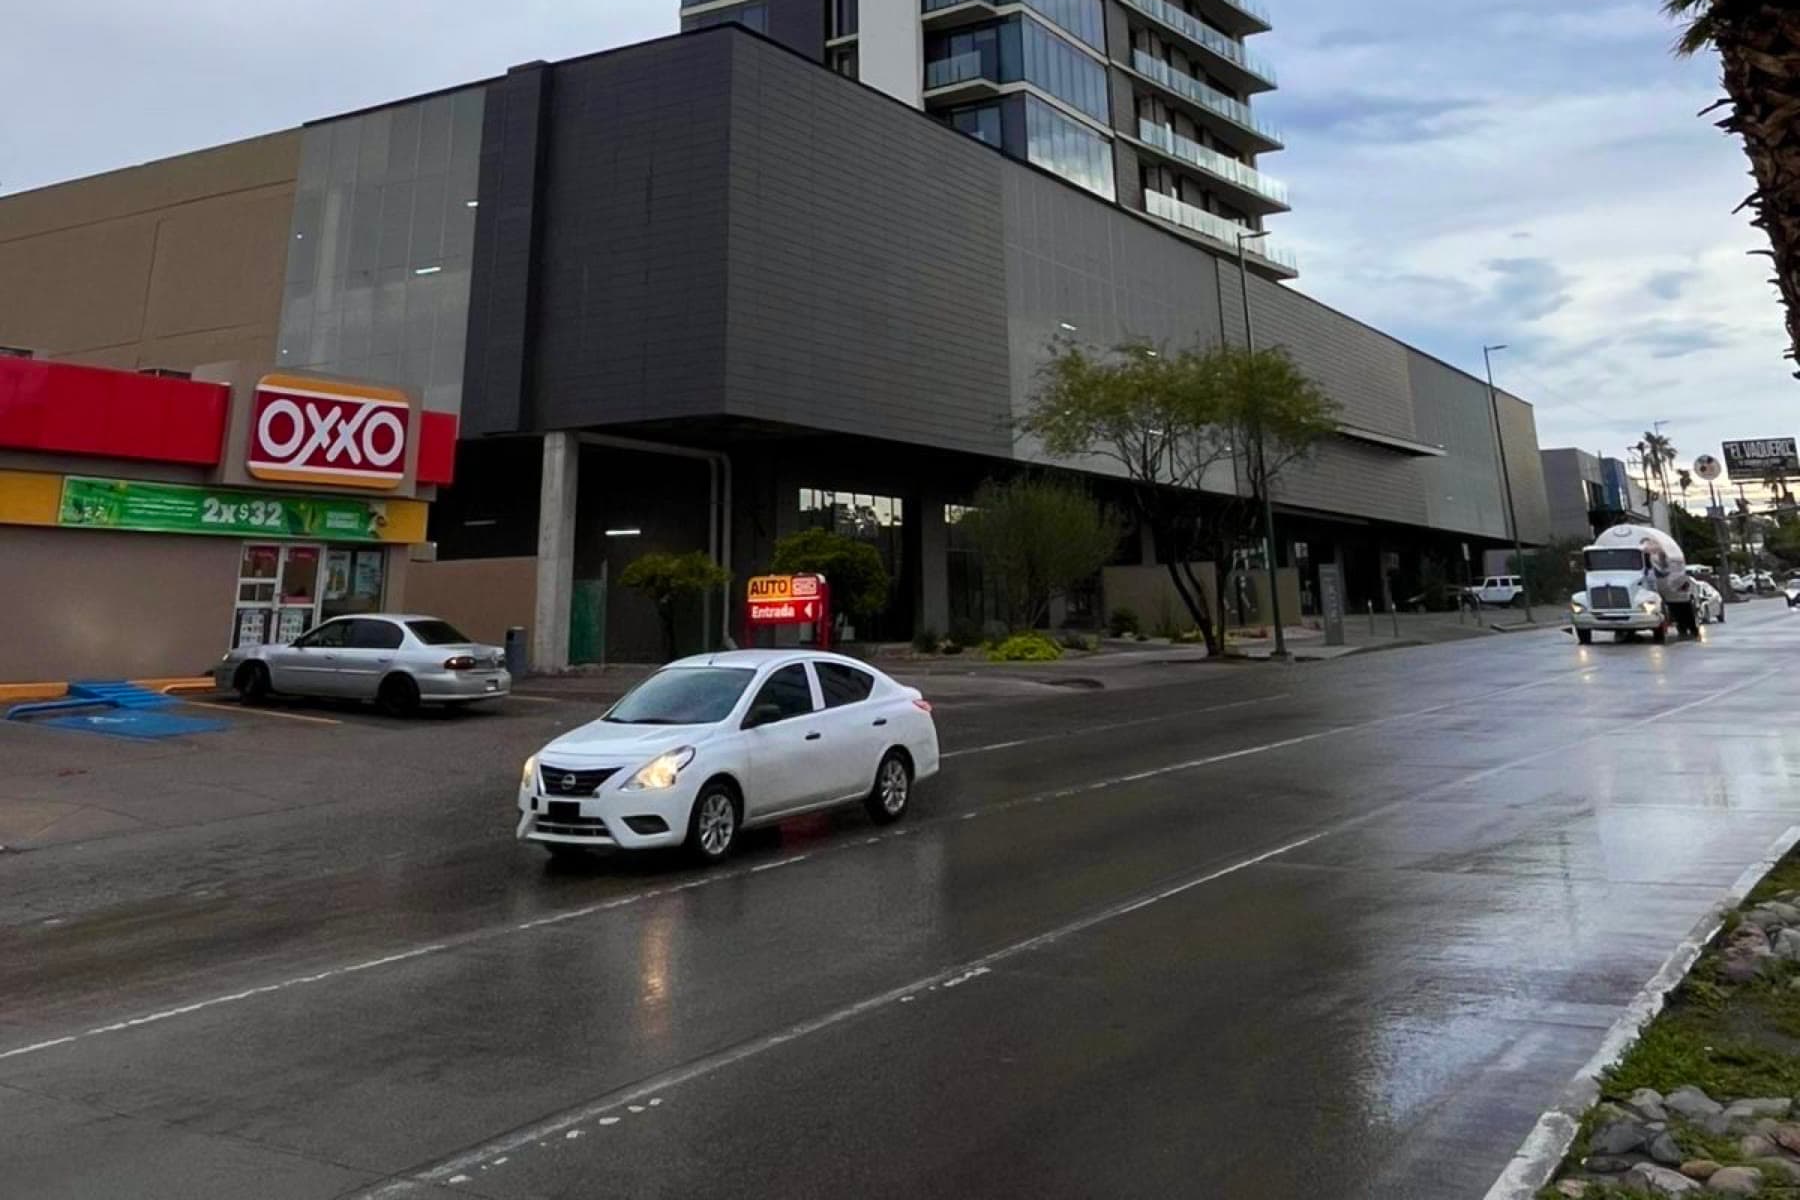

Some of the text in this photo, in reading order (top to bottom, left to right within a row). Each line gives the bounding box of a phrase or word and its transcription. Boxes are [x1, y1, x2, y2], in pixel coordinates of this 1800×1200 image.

[258, 399, 404, 468] OXXO
[750, 580, 787, 595] AUTO
[752, 604, 795, 618] Entrada
